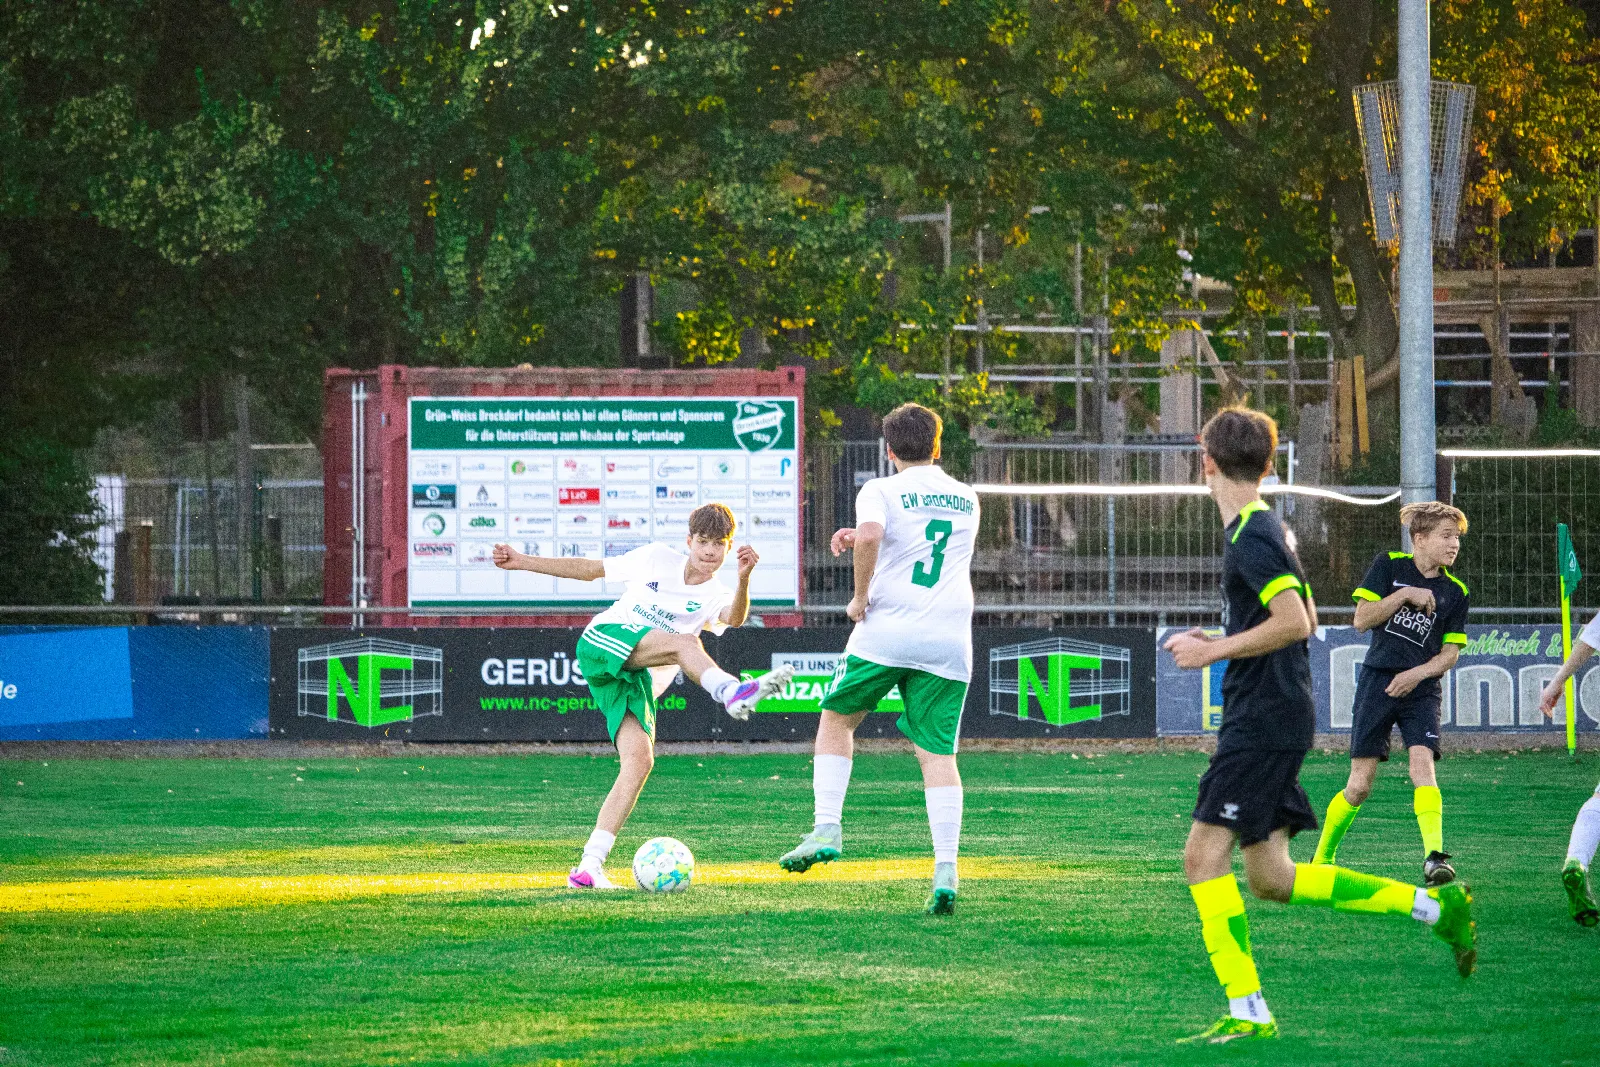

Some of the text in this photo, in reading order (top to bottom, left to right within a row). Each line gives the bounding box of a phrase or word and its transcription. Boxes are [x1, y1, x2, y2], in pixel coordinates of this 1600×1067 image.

[479, 409, 523, 422] Brockdorf
[525, 409, 560, 422] bedankt
[562, 409, 580, 422] sich
[582, 409, 596, 422] bei
[598, 409, 620, 422] allen
[621, 408, 658, 422] Gönnern
[660, 410, 677, 422] und
[678, 409, 725, 425] Sponsoren
[465, 429, 685, 444] für die Unterstützung zum Neubau der Sportanlage
[901, 492, 918, 509] GW
[911, 518, 953, 589] 3
[1545, 632, 1563, 657] &
[808, 660, 834, 671] UNS
